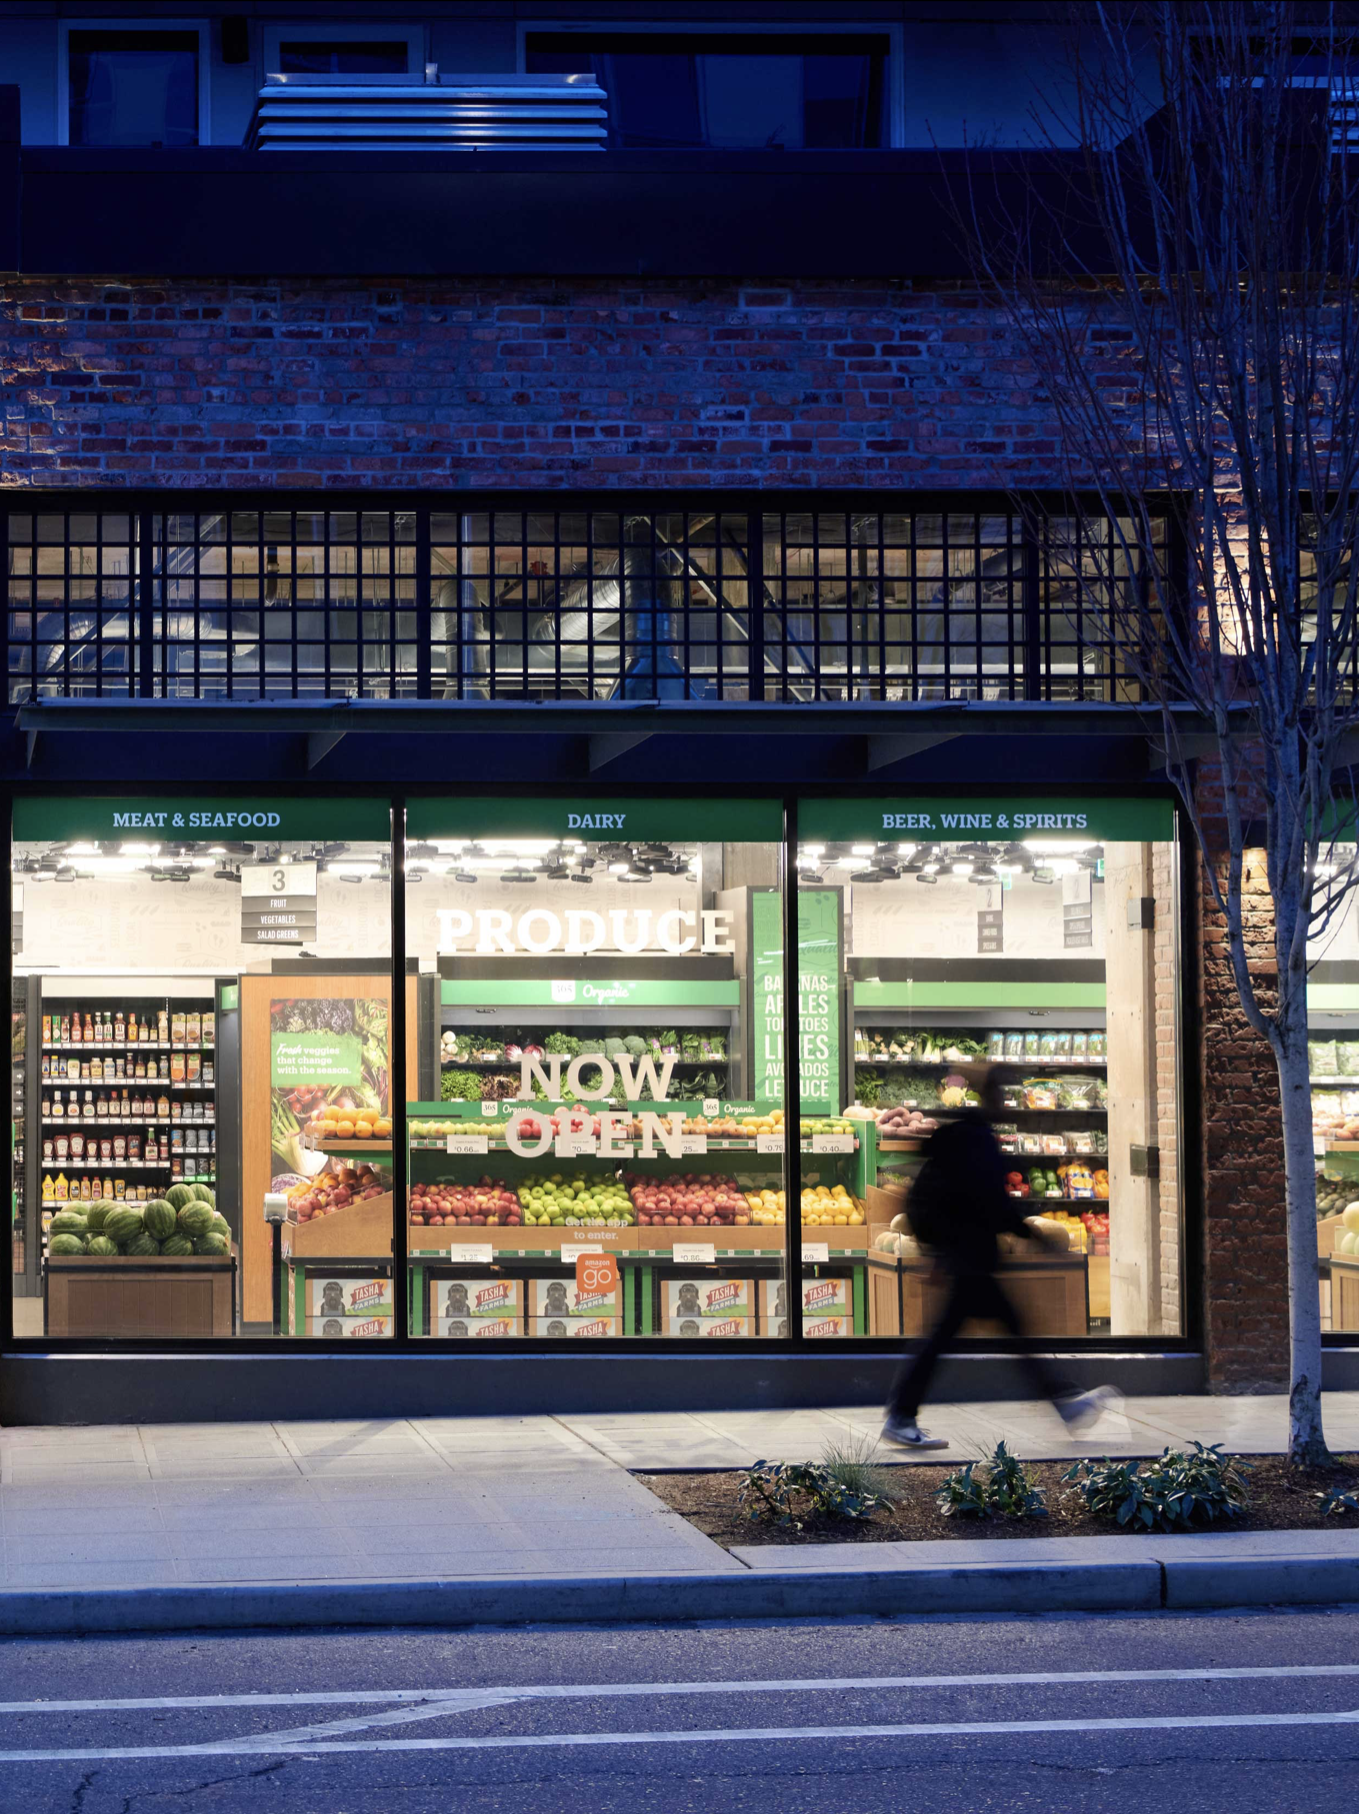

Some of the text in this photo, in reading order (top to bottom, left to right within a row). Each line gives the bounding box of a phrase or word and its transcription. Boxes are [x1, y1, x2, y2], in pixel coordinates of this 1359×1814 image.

[112, 812, 281, 828] MEAT & SEAFOOD
[567, 813, 626, 829] DAIRY
[882, 813, 1087, 831] BEER, WINE & SPIRITS
[272, 869, 286, 892] 3
[270, 898, 287, 908] FRUIT
[260, 914, 296, 924] VEGETABLES
[257, 929, 299, 939] SALAD GREENS
[436, 909, 735, 954] PRODUCE
[582, 983, 629, 1003] Organic
[764, 1017, 829, 1032] TOTOES
[276, 1043, 340, 1056] Fresh veggies
[764, 1034, 829, 1060] LIES
[277, 1056, 332, 1066] that change
[277, 1065, 298, 1074] with
[299, 1065, 315, 1074] the
[516, 1054, 679, 1101] NOW
[483, 1104, 496, 1112] 365
[724, 1103, 756, 1115] Organic
[505, 1110, 687, 1159] OPEN
[565, 1217, 628, 1229] Get the app
[574, 1231, 619, 1239] to enter.
[583, 1269, 612, 1289] go
[355, 1284, 379, 1300] TASHA
[480, 1285, 504, 1302] TASHA
[711, 1284, 735, 1301] TASHA
[809, 1283, 833, 1301] TASHA
[354, 1298, 379, 1310] FARMS
[479, 1299, 504, 1312] FARMS
[579, 1299, 602, 1312] FARMS
[710, 1299, 735, 1312] FARMS
[808, 1298, 833, 1311] FARMS
[355, 1321, 379, 1337] TASHA
[480, 1322, 505, 1336] TASHA
[579, 1322, 603, 1336] TASHA
[712, 1321, 736, 1336] TASHA
[810, 1321, 834, 1336] TASHA
